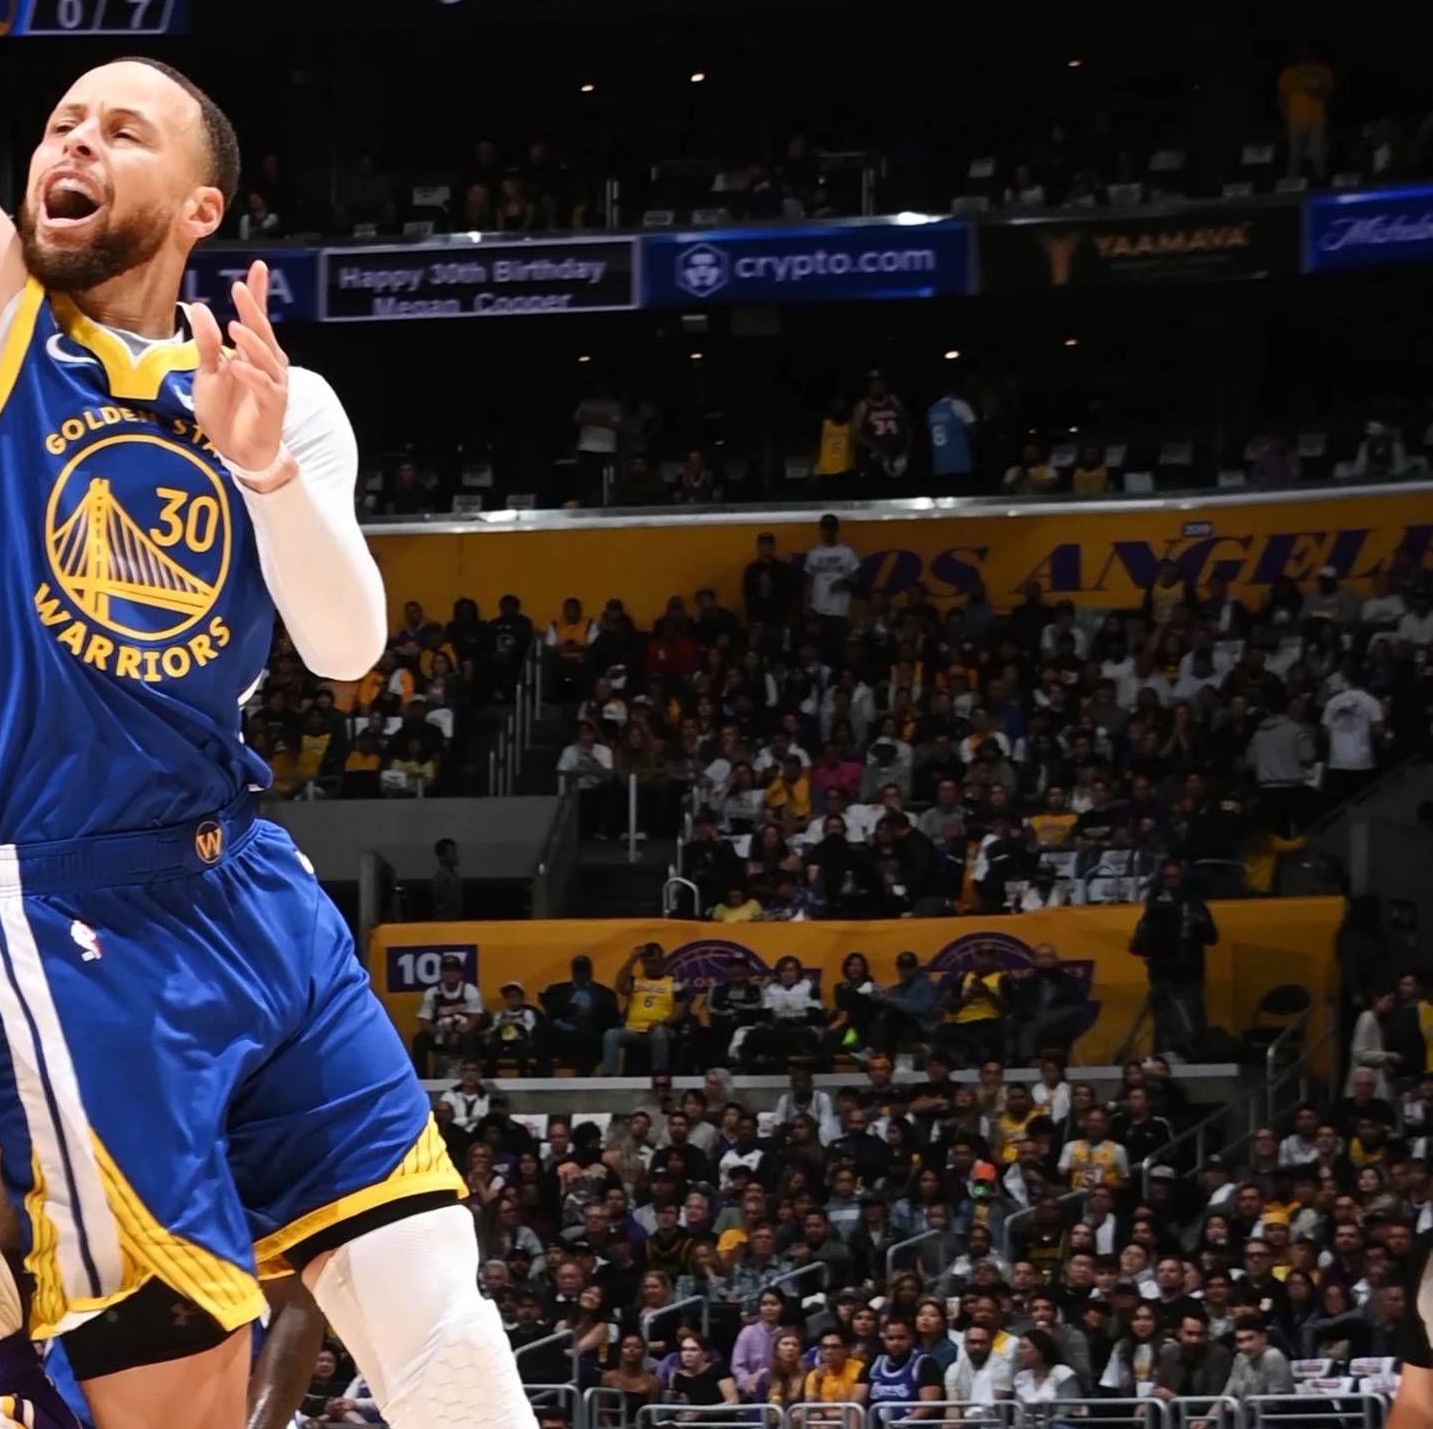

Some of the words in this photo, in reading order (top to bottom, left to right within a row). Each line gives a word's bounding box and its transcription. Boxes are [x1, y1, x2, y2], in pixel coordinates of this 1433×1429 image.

[338, 266, 424, 293] Happy
[429, 262, 488, 285] 30th
[492, 258, 607, 285] Birthday
[734, 249, 936, 282] crypto.com
[150, 486, 220, 553] 30
[33, 582, 232, 682] WARRIORS
